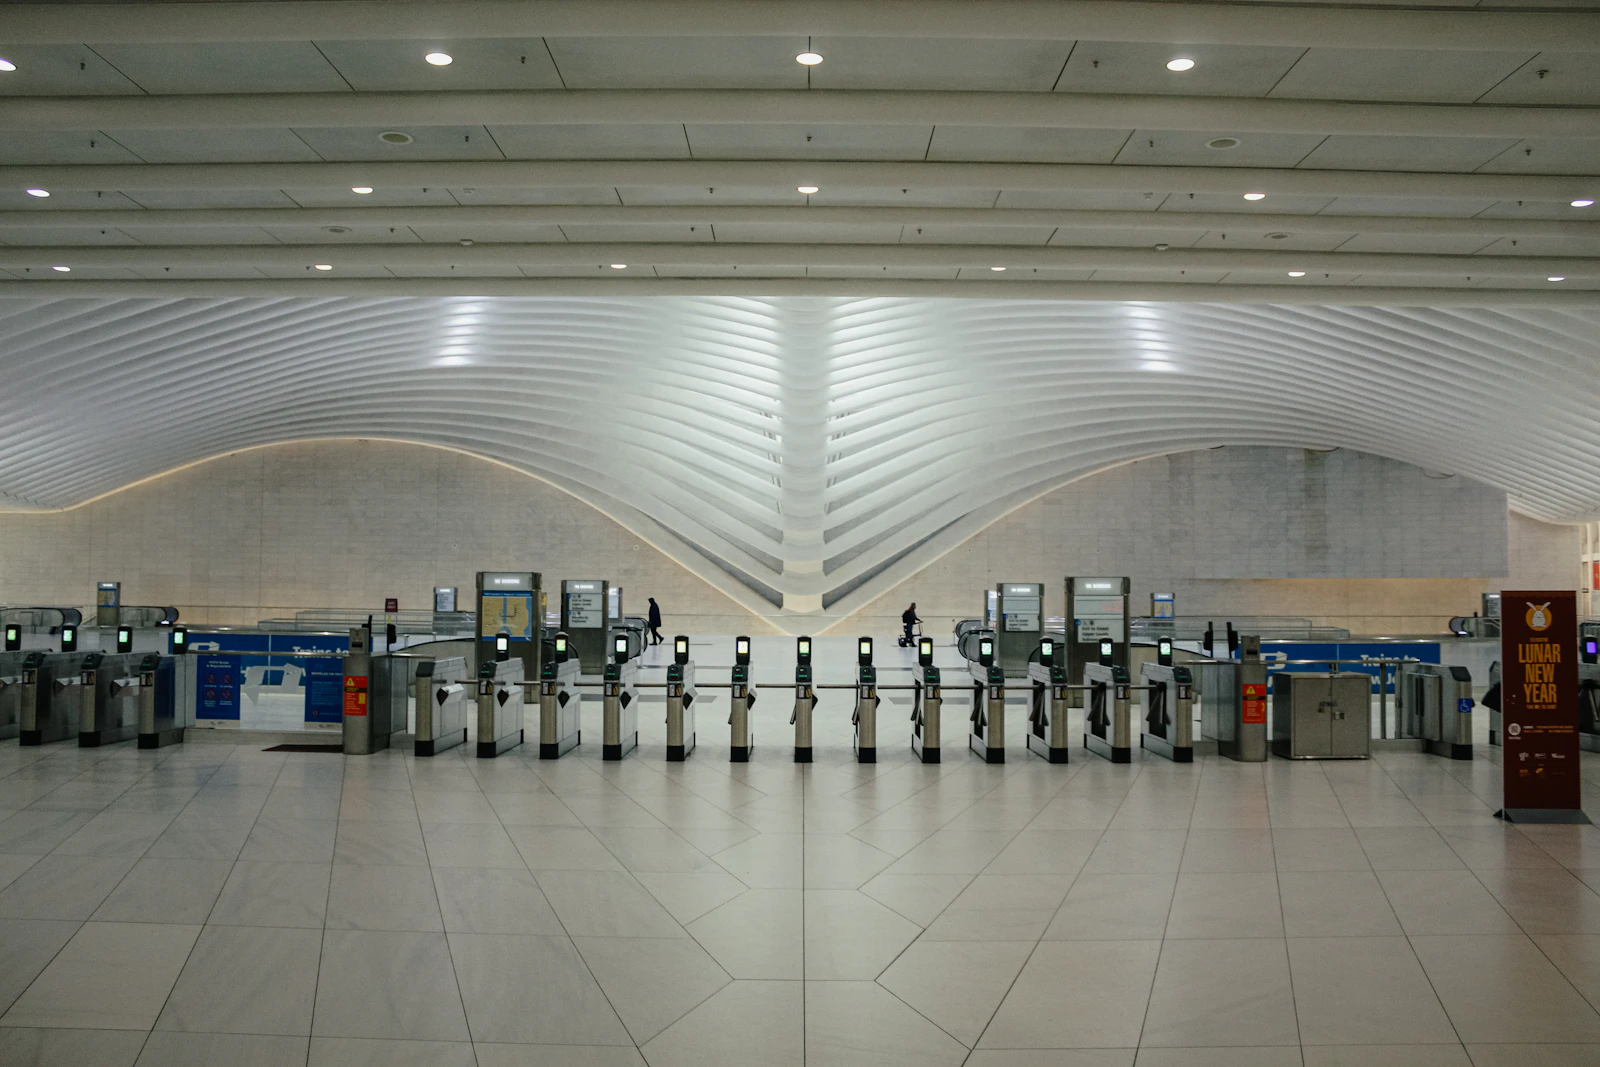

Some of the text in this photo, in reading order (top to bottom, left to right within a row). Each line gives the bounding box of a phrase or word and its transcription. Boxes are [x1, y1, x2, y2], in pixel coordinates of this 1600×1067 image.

[1518, 643, 1561, 663] LUNAR
[1525, 663, 1555, 683] NEW
[1523, 683, 1557, 703] YEAR
